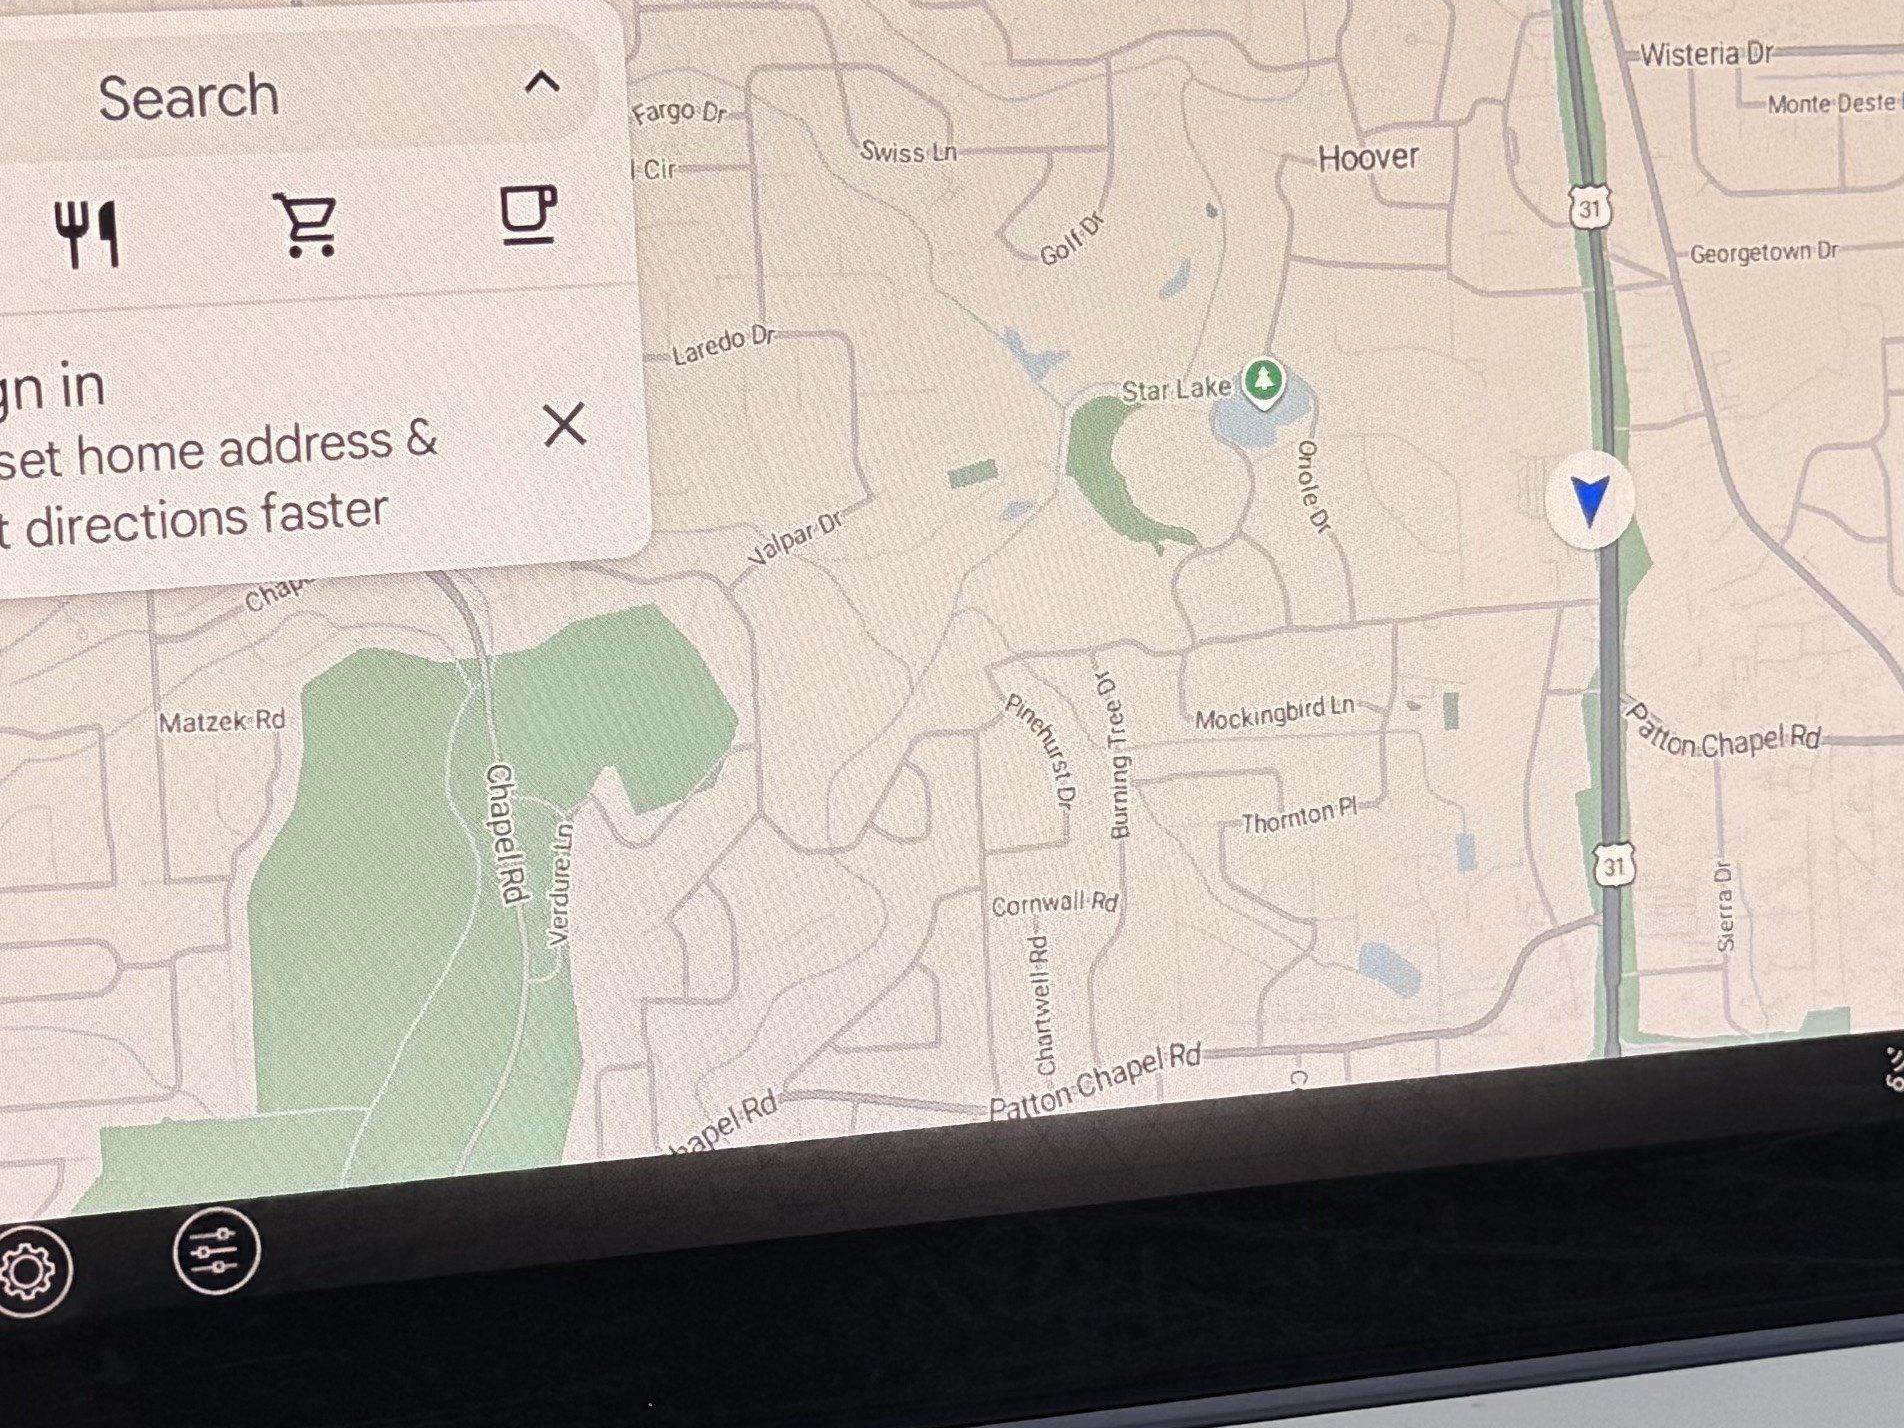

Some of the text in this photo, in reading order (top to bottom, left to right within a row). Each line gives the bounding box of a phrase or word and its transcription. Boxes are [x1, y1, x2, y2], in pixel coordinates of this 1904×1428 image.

[1640, 41, 1774, 67] Wisteria Dr
[99, 71, 279, 122] Search
[631, 101, 728, 126] Fargo Dr
[1768, 95, 1830, 114] Monte
[644, 158, 676, 180] Cir
[860, 141, 957, 163] Swiss Ln
[1319, 144, 1420, 172] Hoover
[1580, 201, 1600, 217] 31
[1040, 210, 1105, 267] Golf Dr
[1690, 242, 1839, 266] Georgetown Dr
[672, 324, 776, 366] Laredo Dr
[62, 360, 105, 408] in
[1122, 376, 1232, 403] Star Lake
[78, 435, 204, 475] home
[220, 422, 393, 466] address
[407, 417, 438, 455] &
[1297, 441, 1331, 534] Oriole Dr
[26, 500, 248, 548] directions
[261, 492, 390, 532] faster
[748, 512, 844, 569] Valpar Dr
[159, 707, 285, 735] Matzek Rd
[1196, 695, 1354, 730] Mockingbird Ln
[1625, 702, 1821, 757] Patton Chapel Rd
[1005, 692, 1075, 810] Pinehurst Dr
[1096, 671, 1132, 839] Burning Tree Dr
[485, 763, 530, 905] Chapel Rd
[1243, 796, 1358, 834] Thornton Pl
[547, 822, 574, 946] Verdure Ln
[1604, 859, 1624, 876] 31
[992, 891, 1119, 916] Cornwall Rd
[1714, 859, 1735, 953] Sierra Dr
[1028, 935, 1055, 1076] Chartwell Rd
[990, 1041, 1201, 1122] Patton Chapel Rd
[742, 1088, 778, 1123] Rd
